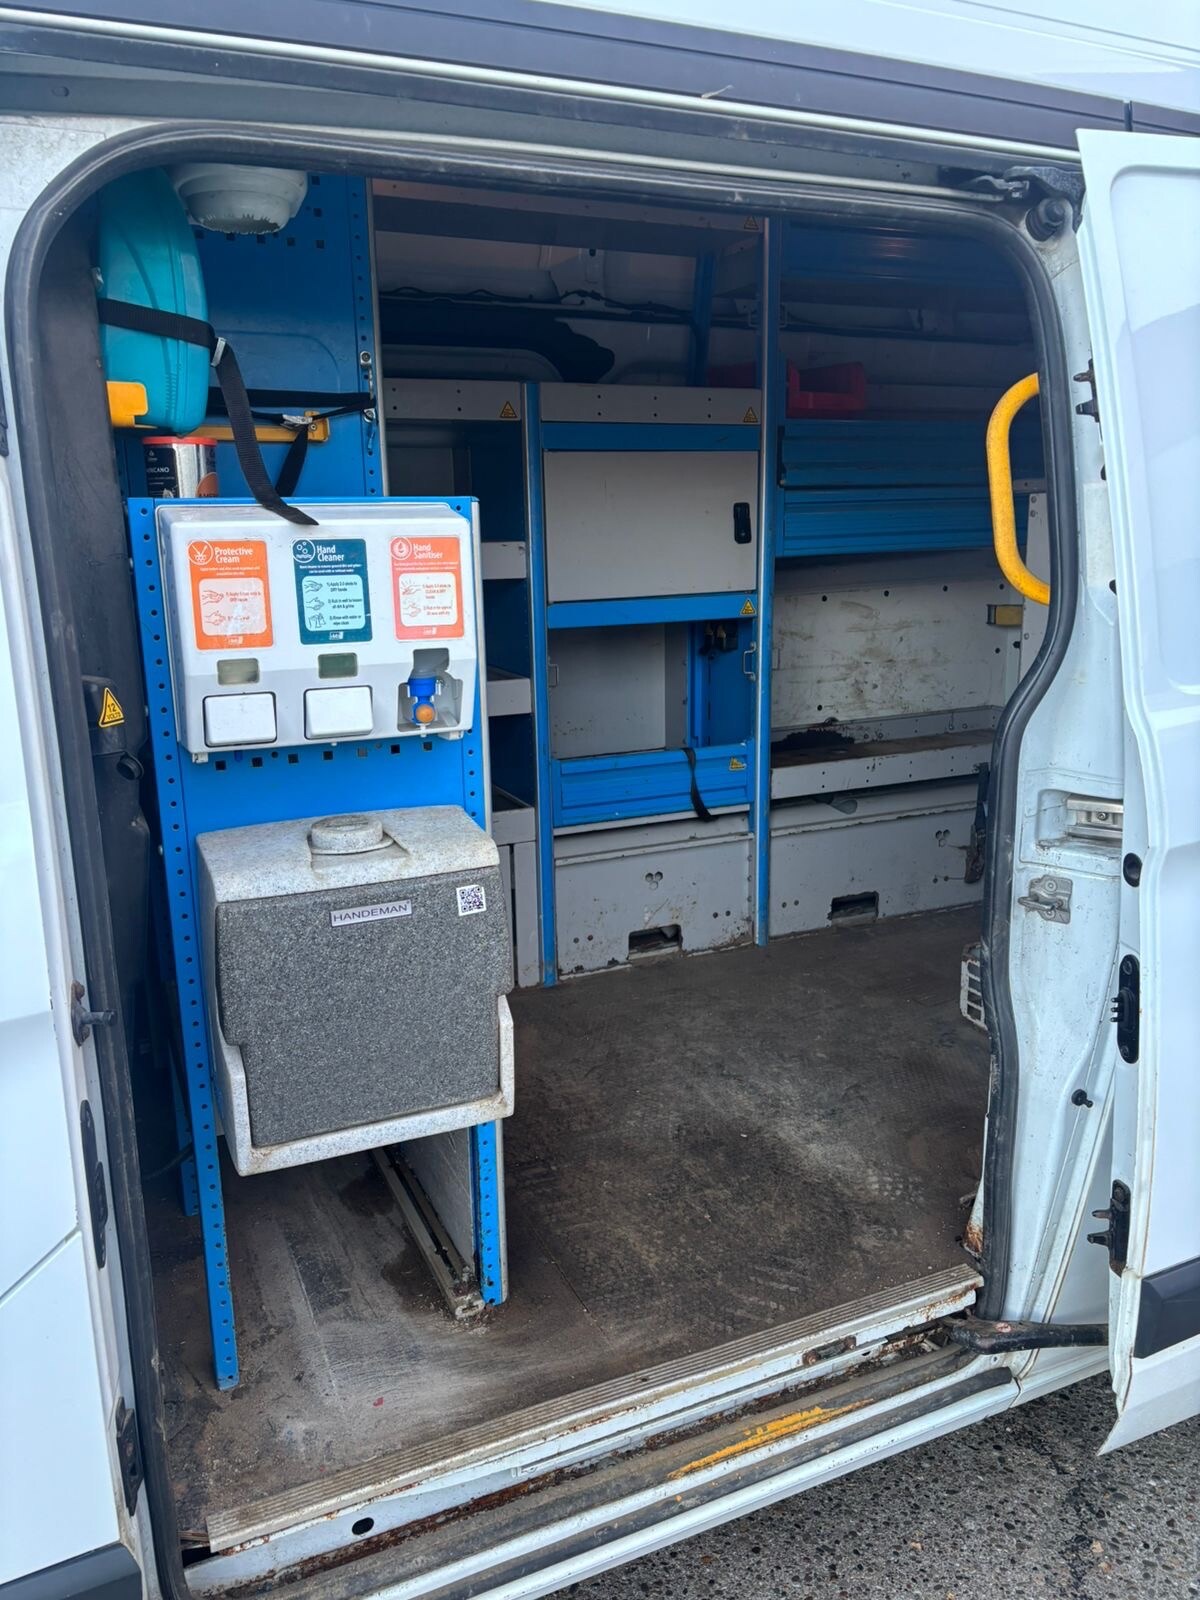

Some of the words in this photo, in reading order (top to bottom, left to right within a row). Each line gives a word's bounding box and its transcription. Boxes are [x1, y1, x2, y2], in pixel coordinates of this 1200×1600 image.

[214, 546, 254, 556] Protective
[316, 545, 336, 554] Hand
[413, 543, 432, 552] Hand
[215, 555, 241, 564] Cream
[317, 553, 345, 562] Cleaner
[107, 703, 117, 713] 12
[333, 903, 408, 922] HANDEMAN
